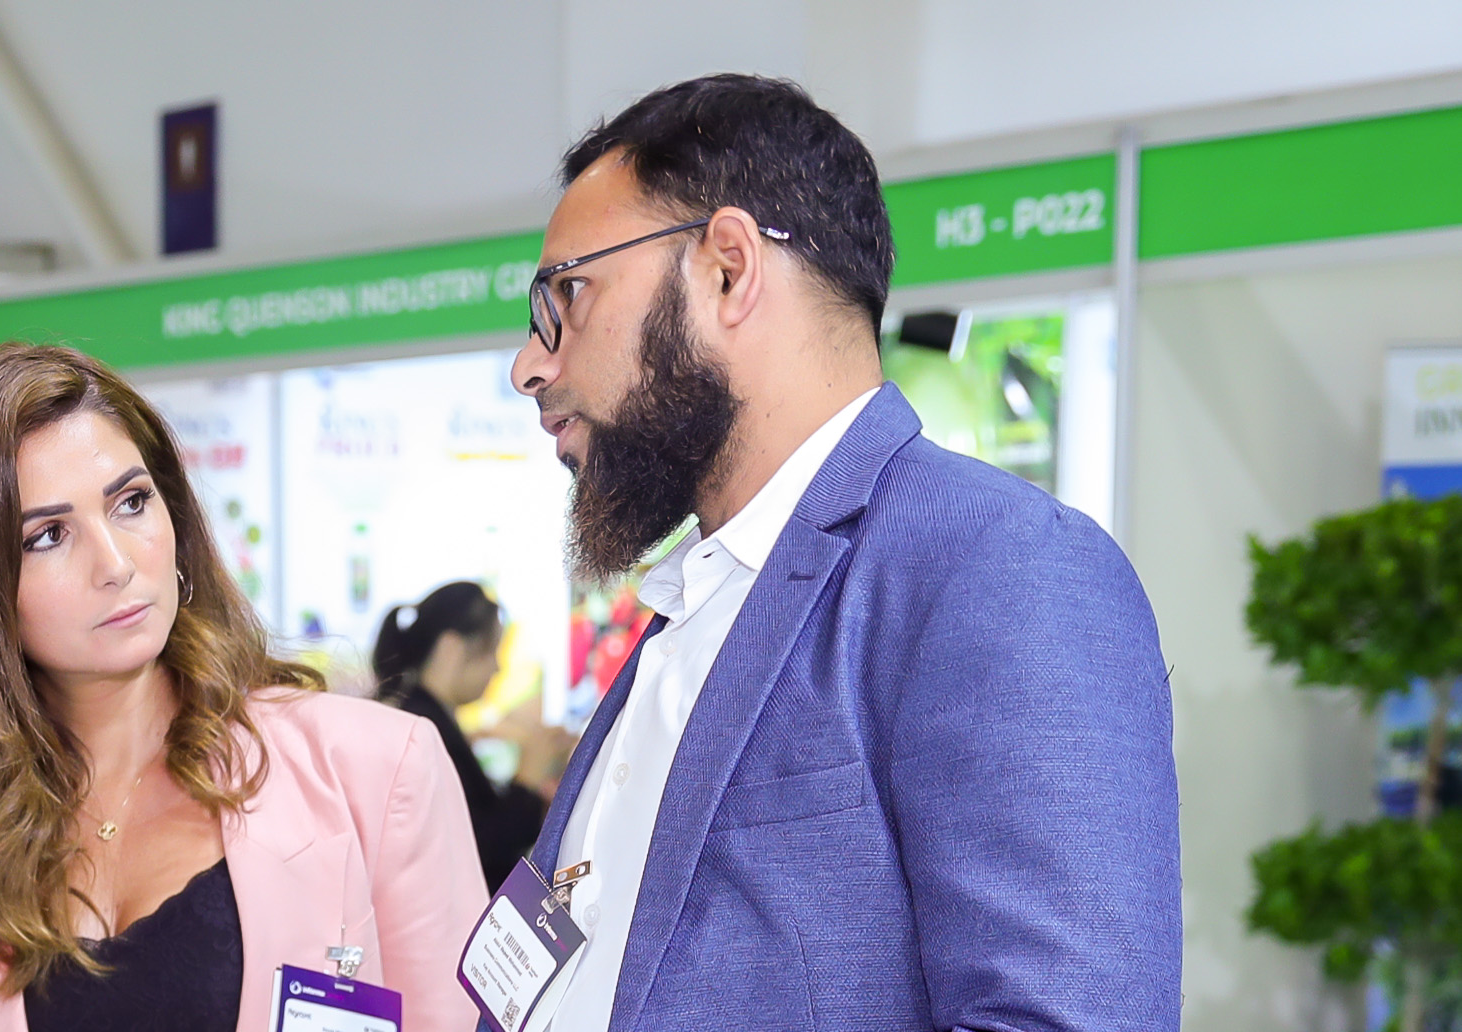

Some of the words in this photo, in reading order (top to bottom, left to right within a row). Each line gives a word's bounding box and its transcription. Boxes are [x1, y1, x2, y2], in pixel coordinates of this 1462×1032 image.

[936, 203, 985, 248] H3
[1012, 188, 1105, 240] P022
[162, 300, 221, 338] KING
[224, 287, 351, 337] QUENSON
[358, 266, 491, 316] INDUSTRY
[469, 963, 488, 989] VISITOR
